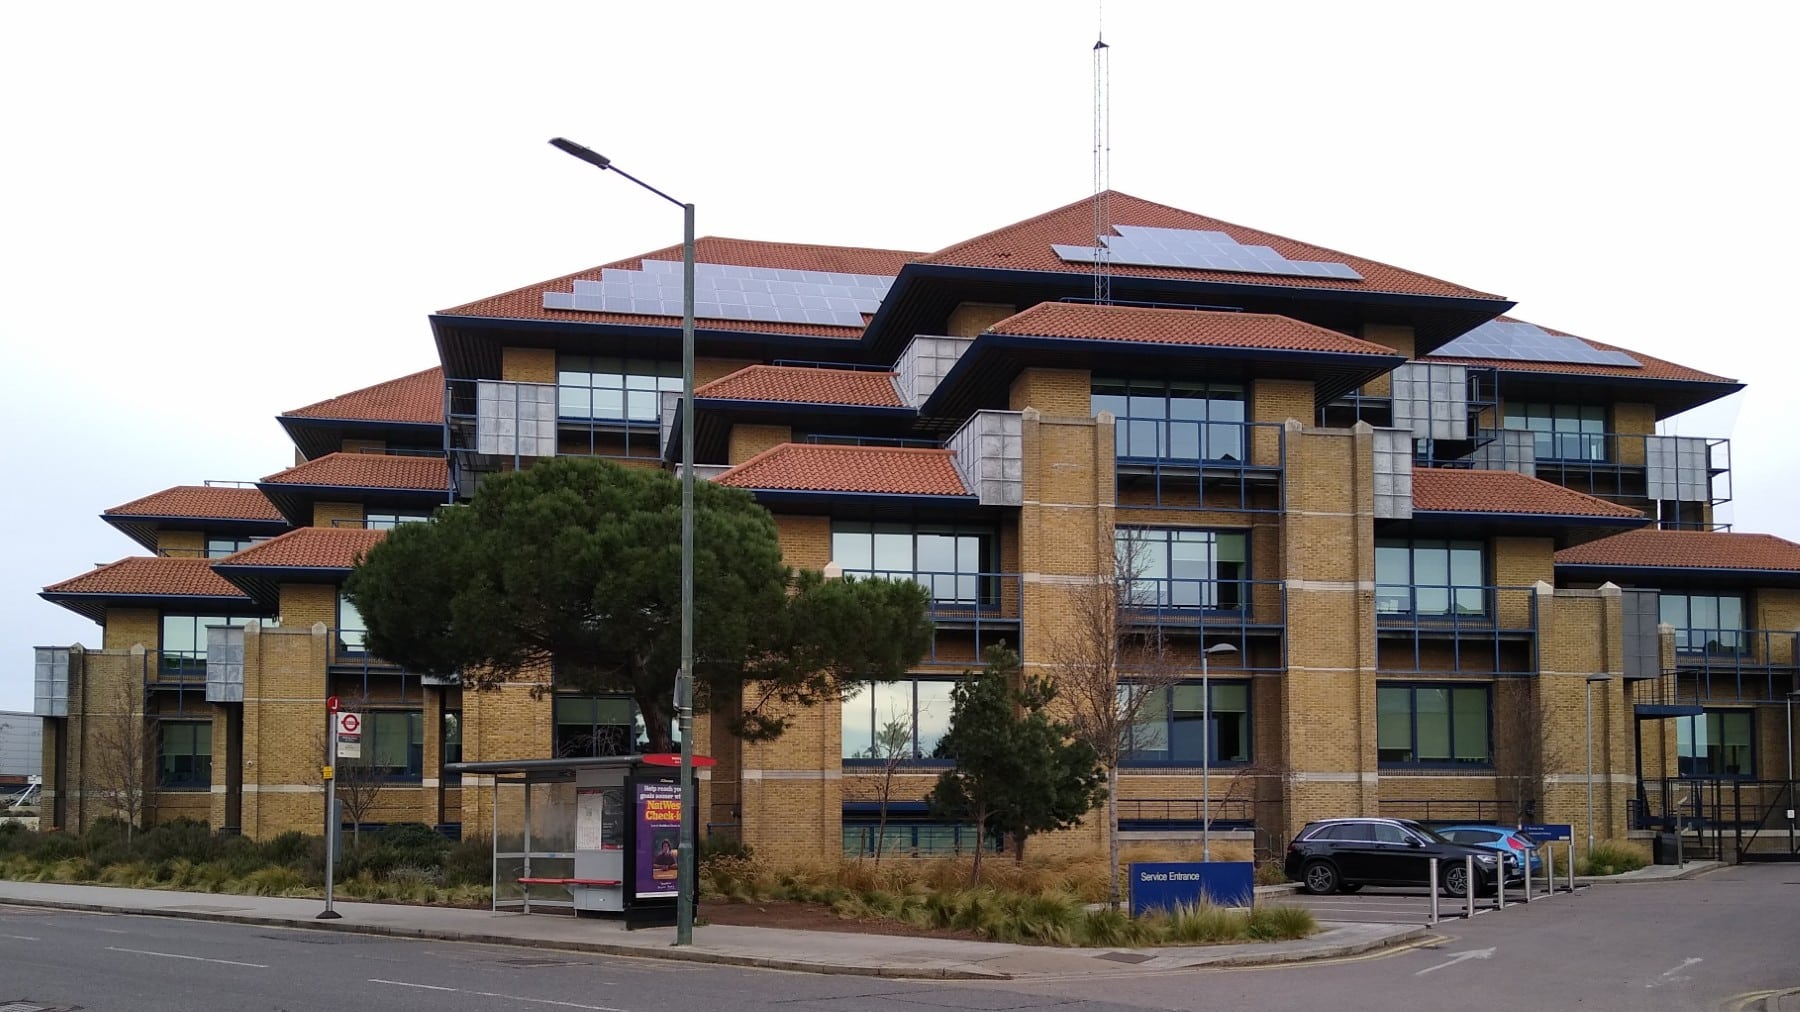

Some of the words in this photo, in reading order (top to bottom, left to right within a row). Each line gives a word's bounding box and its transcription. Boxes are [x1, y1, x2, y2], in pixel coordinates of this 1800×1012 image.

[332, 699, 338, 709] J
[647, 800, 681, 809] NatWes
[1141, 872, 1167, 881] Service
[1169, 871, 1200, 881] Entrance
